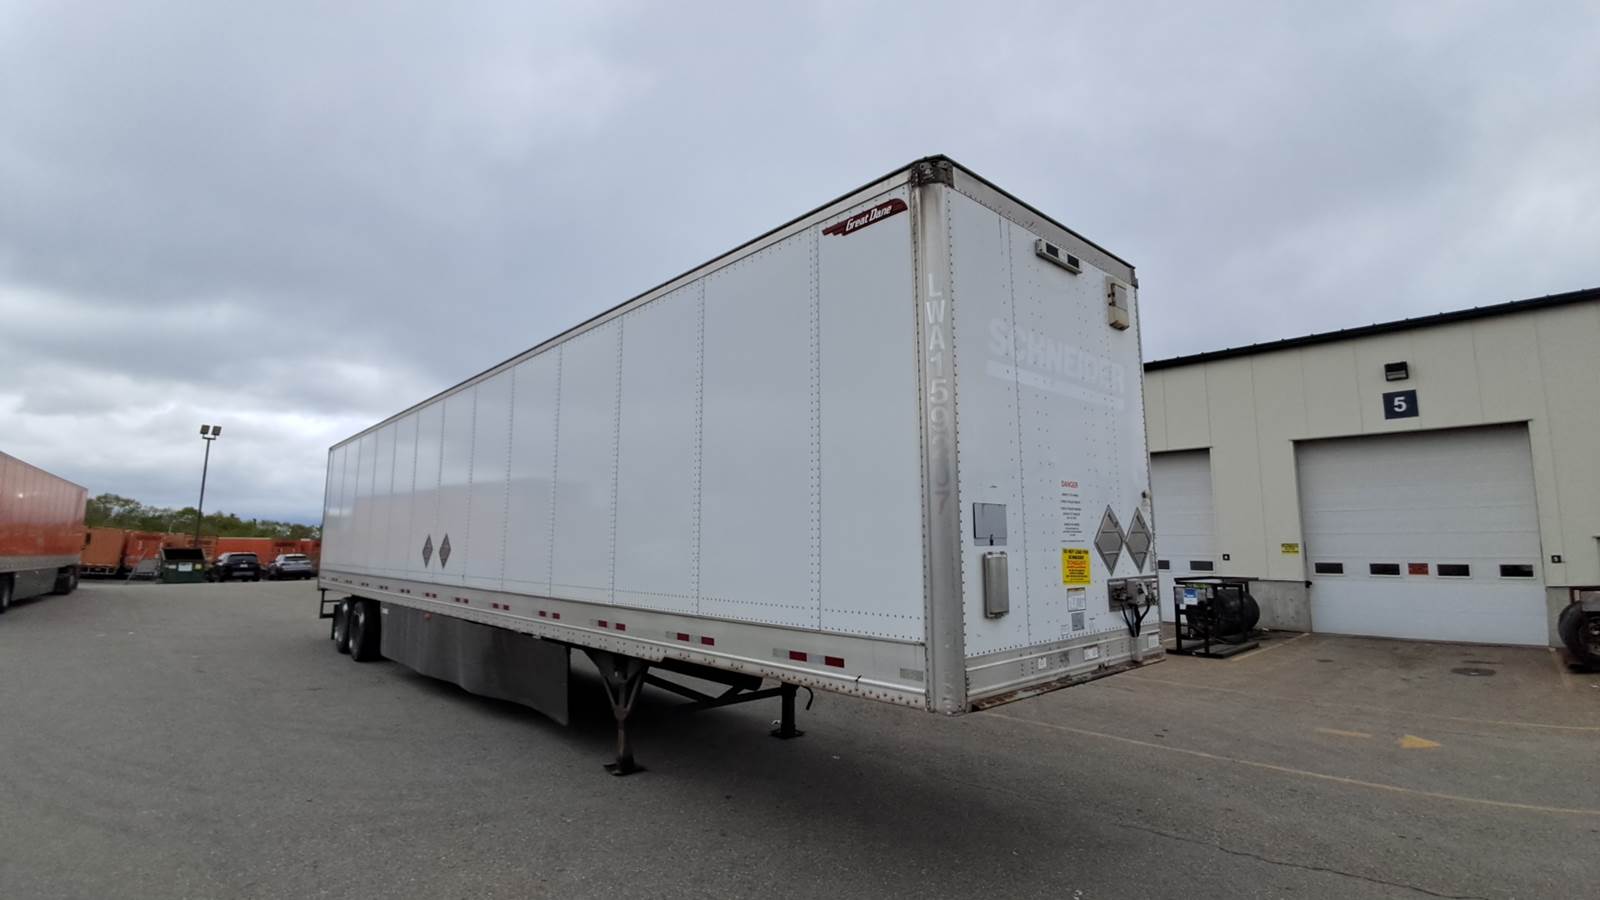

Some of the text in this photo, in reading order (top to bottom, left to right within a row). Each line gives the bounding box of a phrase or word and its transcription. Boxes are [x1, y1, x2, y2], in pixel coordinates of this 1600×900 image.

[845, 205, 893, 232] Great Dane
[1393, 396, 1407, 412] 5
